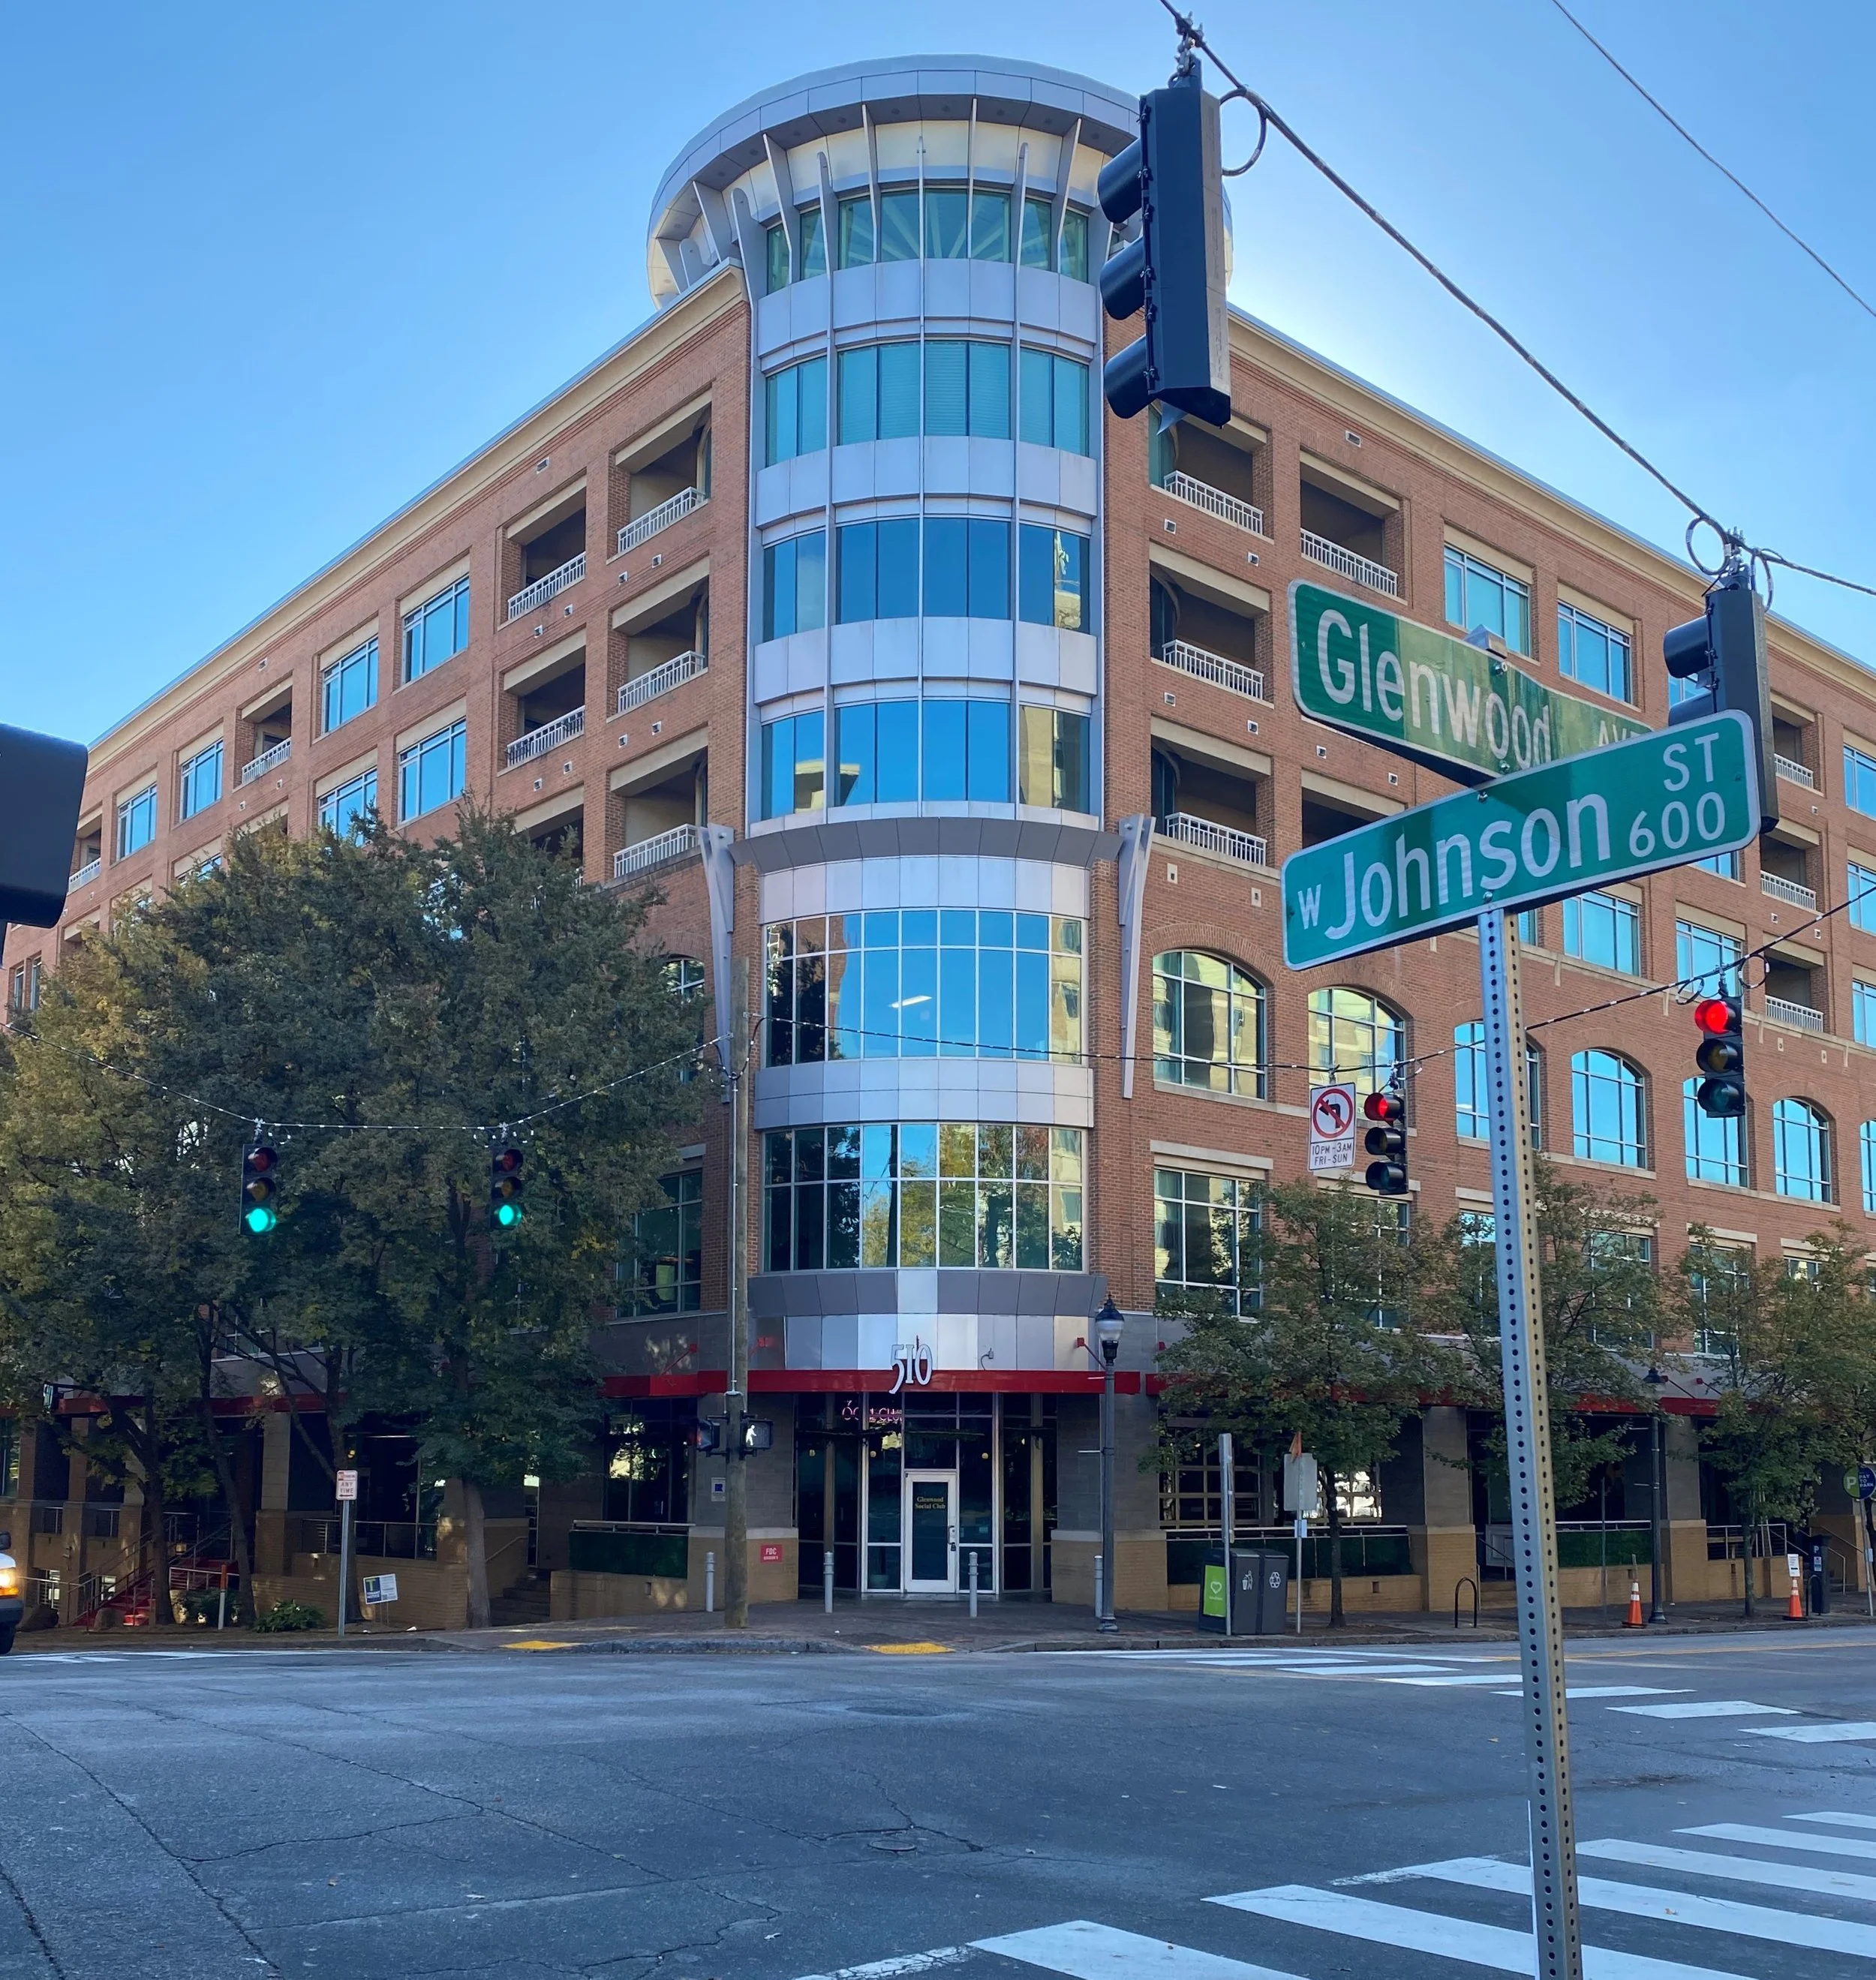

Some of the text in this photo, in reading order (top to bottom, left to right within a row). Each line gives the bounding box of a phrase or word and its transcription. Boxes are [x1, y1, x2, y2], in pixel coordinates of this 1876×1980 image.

[1317, 608, 1642, 769] Glenwood AV
[1662, 733, 1721, 792] ST
[1628, 792, 1725, 858] 600
[1298, 792, 1610, 941] W Johnson
[888, 1343, 933, 1395] 510
[1846, 1476, 1856, 1489] P
[765, 1547, 777, 1555] FDC
